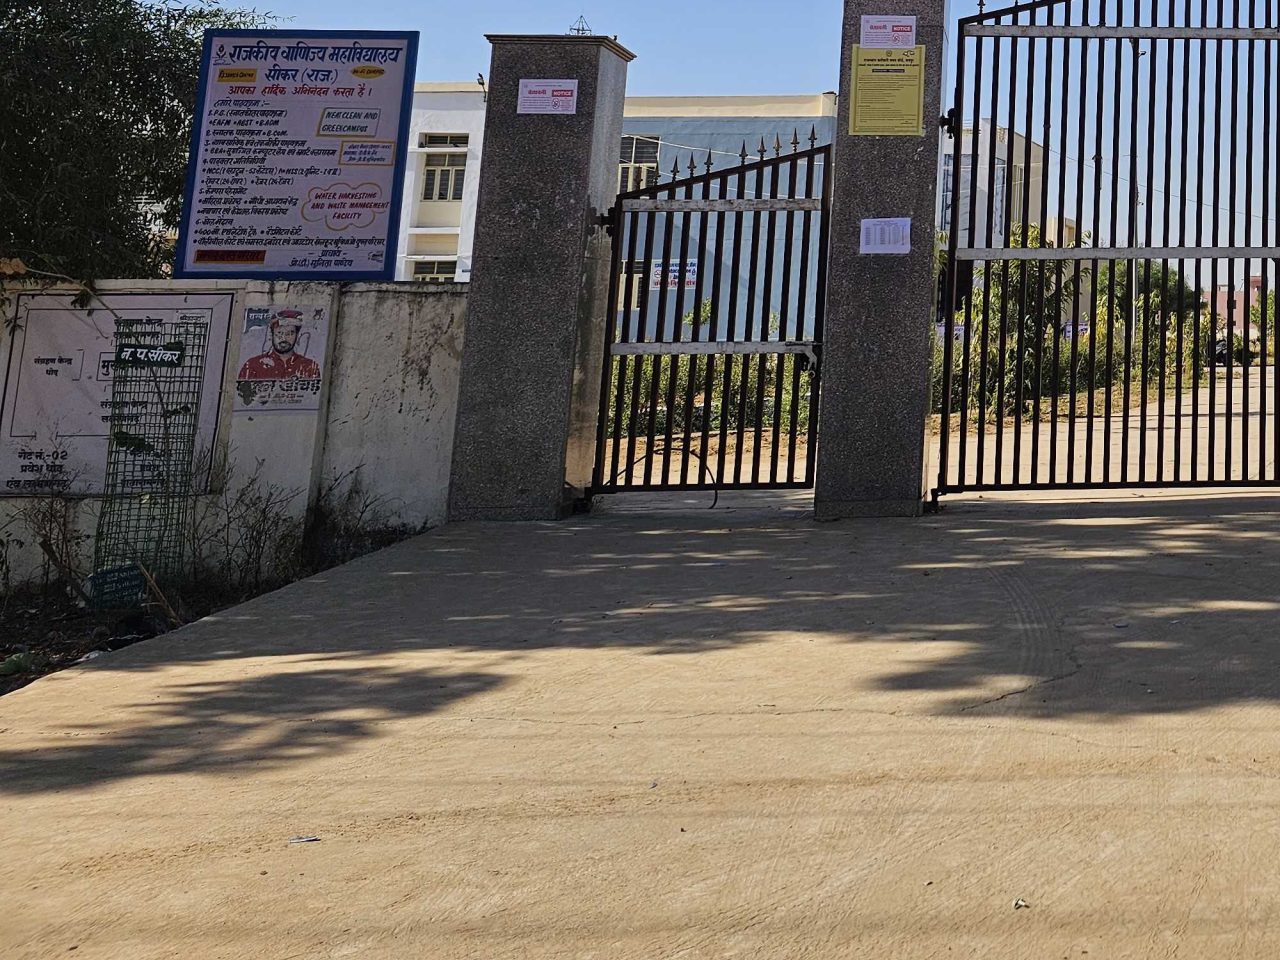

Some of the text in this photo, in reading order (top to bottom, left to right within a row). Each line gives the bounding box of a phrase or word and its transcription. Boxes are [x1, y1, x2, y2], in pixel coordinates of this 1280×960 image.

[229, 40, 402, 64] राजकीय वाणिज्य महाविद्यालय
[265, 63, 299, 82] सीकर
[228, 86, 256, 96] आपका
[261, 83, 286, 96] हार्दिक
[333, 87, 354, 98] करता
[148, 347, 181, 363] सीकर
